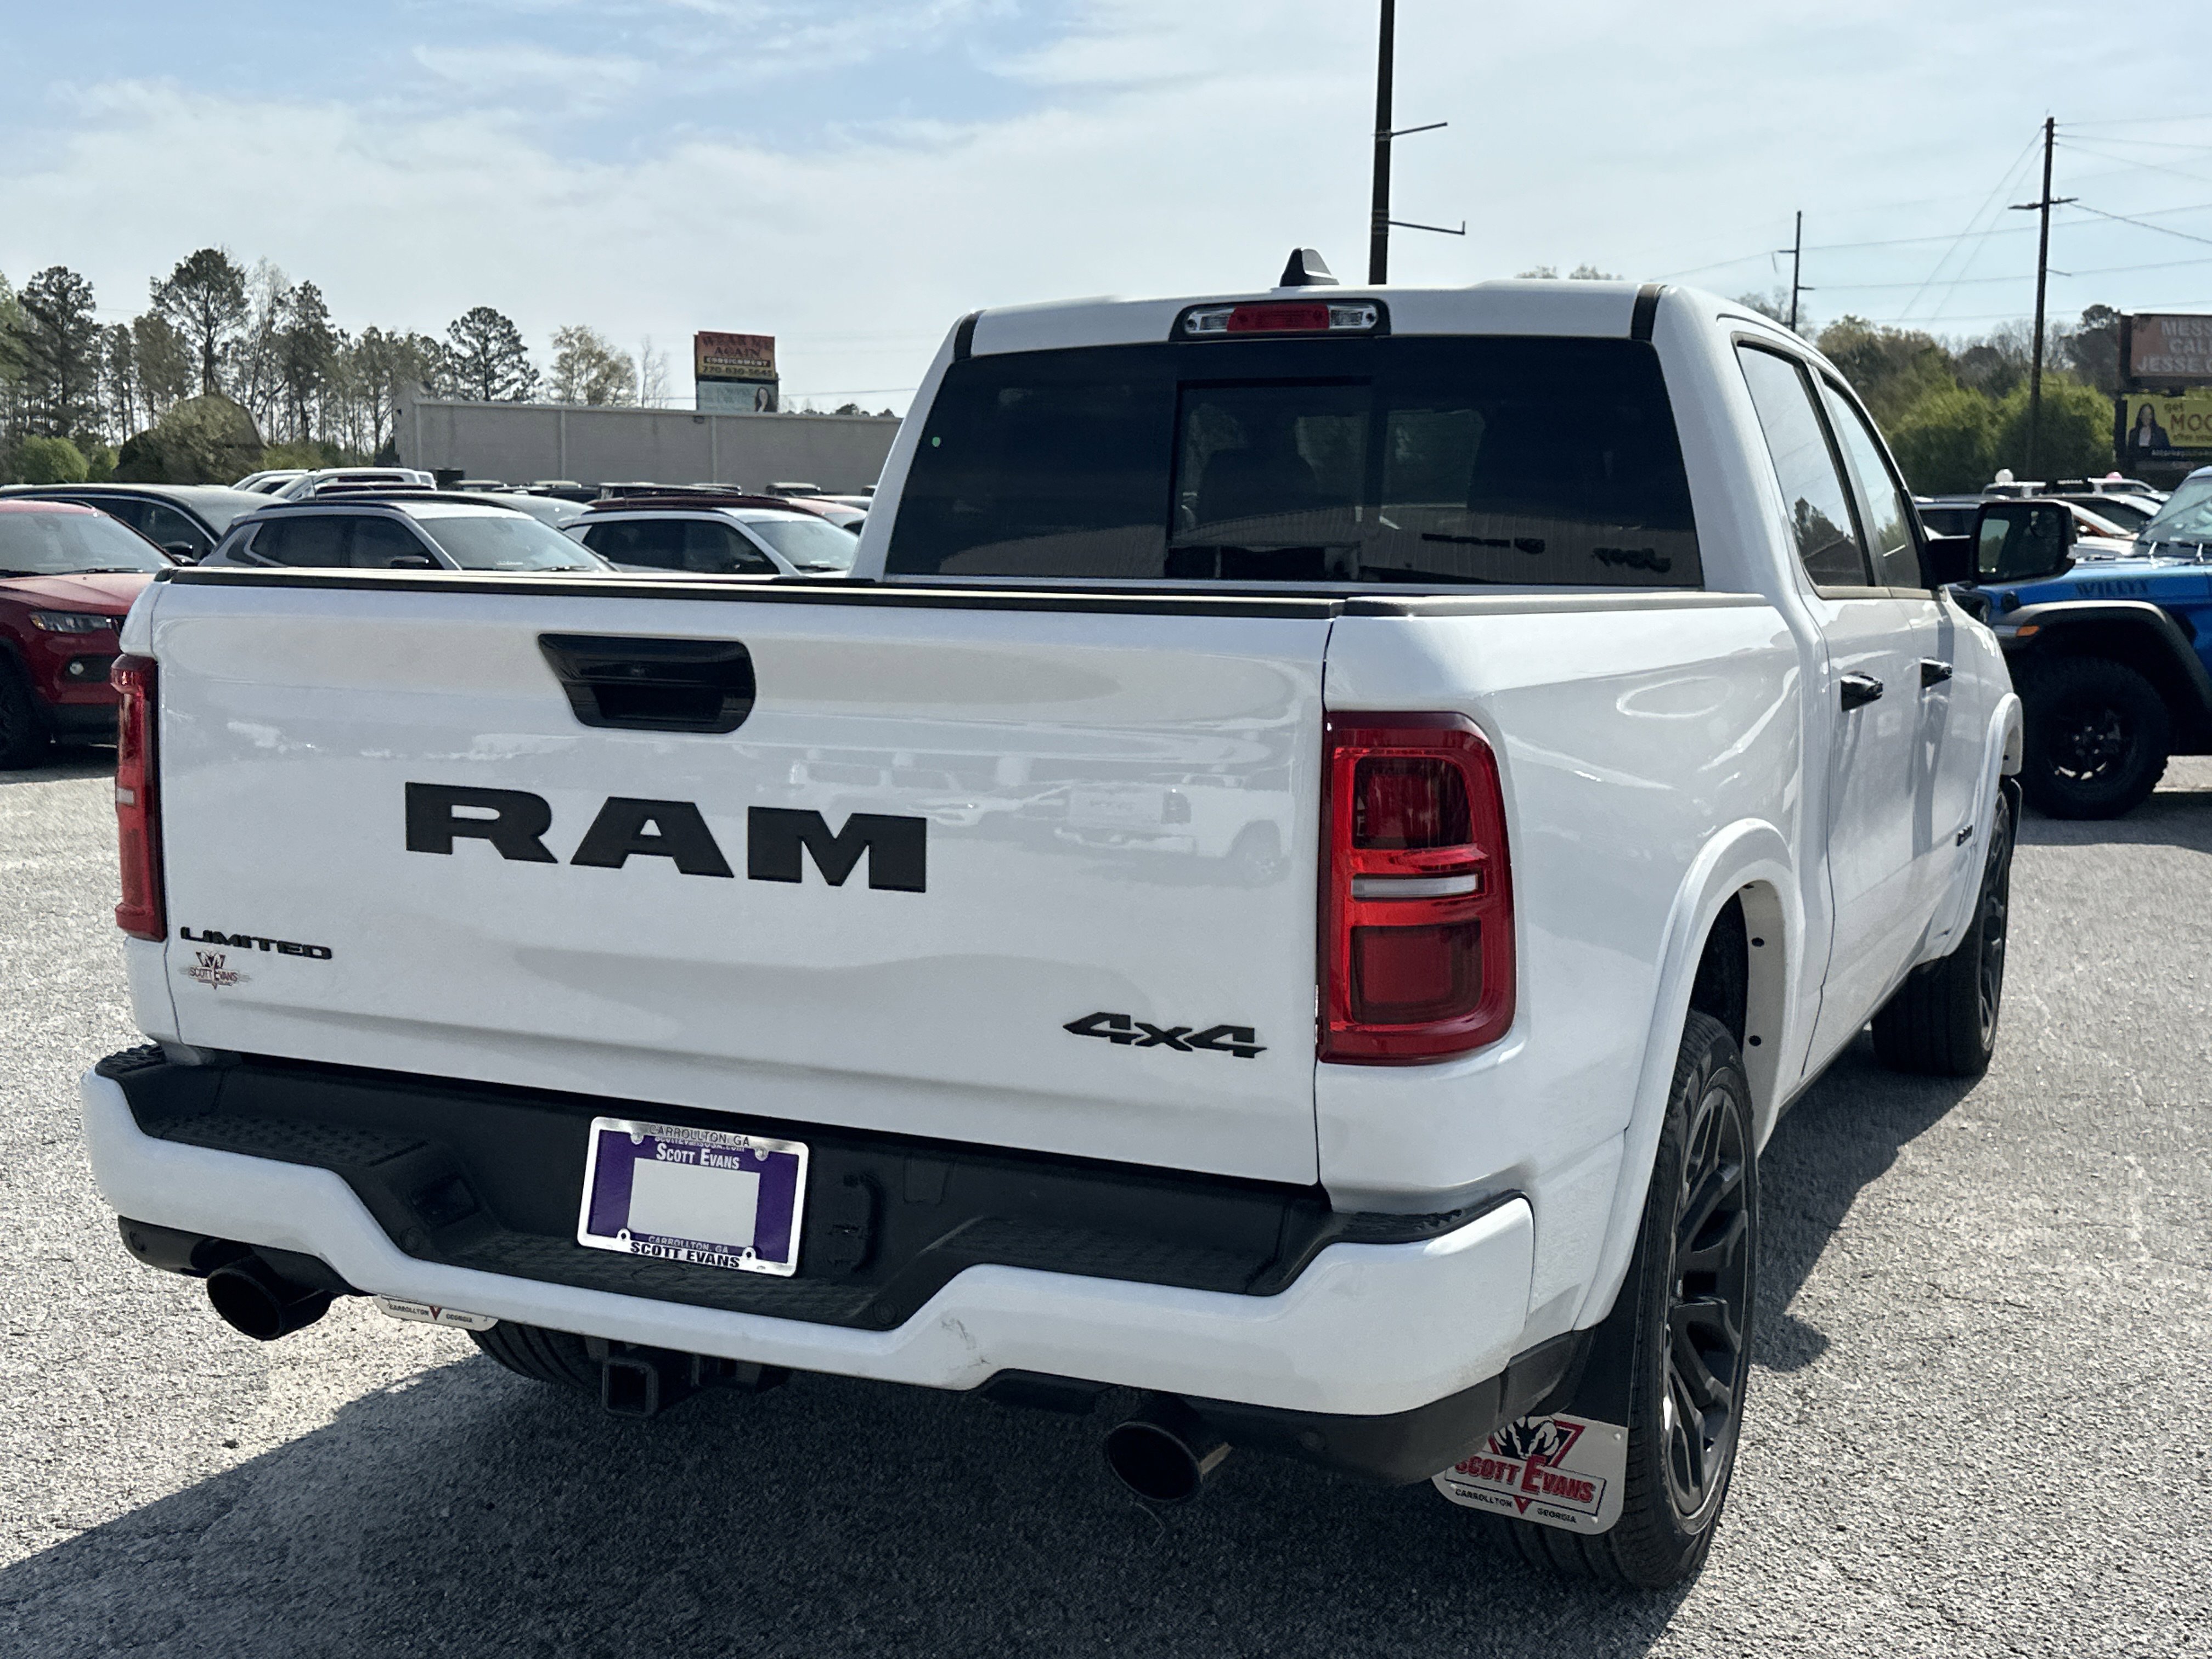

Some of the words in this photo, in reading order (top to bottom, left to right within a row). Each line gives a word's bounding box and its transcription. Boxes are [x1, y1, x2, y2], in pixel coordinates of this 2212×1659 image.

[715, 346, 761, 357] AGAIN
[405, 781, 927, 893] RAM
[180, 926, 332, 960] LIMITED
[733, 1135, 750, 1146] GA
[656, 1142, 696, 1164] SCOTT
[700, 1148, 740, 1170] EVANS
[630, 1242, 682, 1259] SCOTT
[686, 1250, 740, 1268] EVANS
[715, 1245, 729, 1254] GA
[1521, 1454, 1596, 1503] EVANS
[1455, 1488, 1513, 1508] CARROLLTON
[1537, 1508, 1577, 1523] GEORGIA
